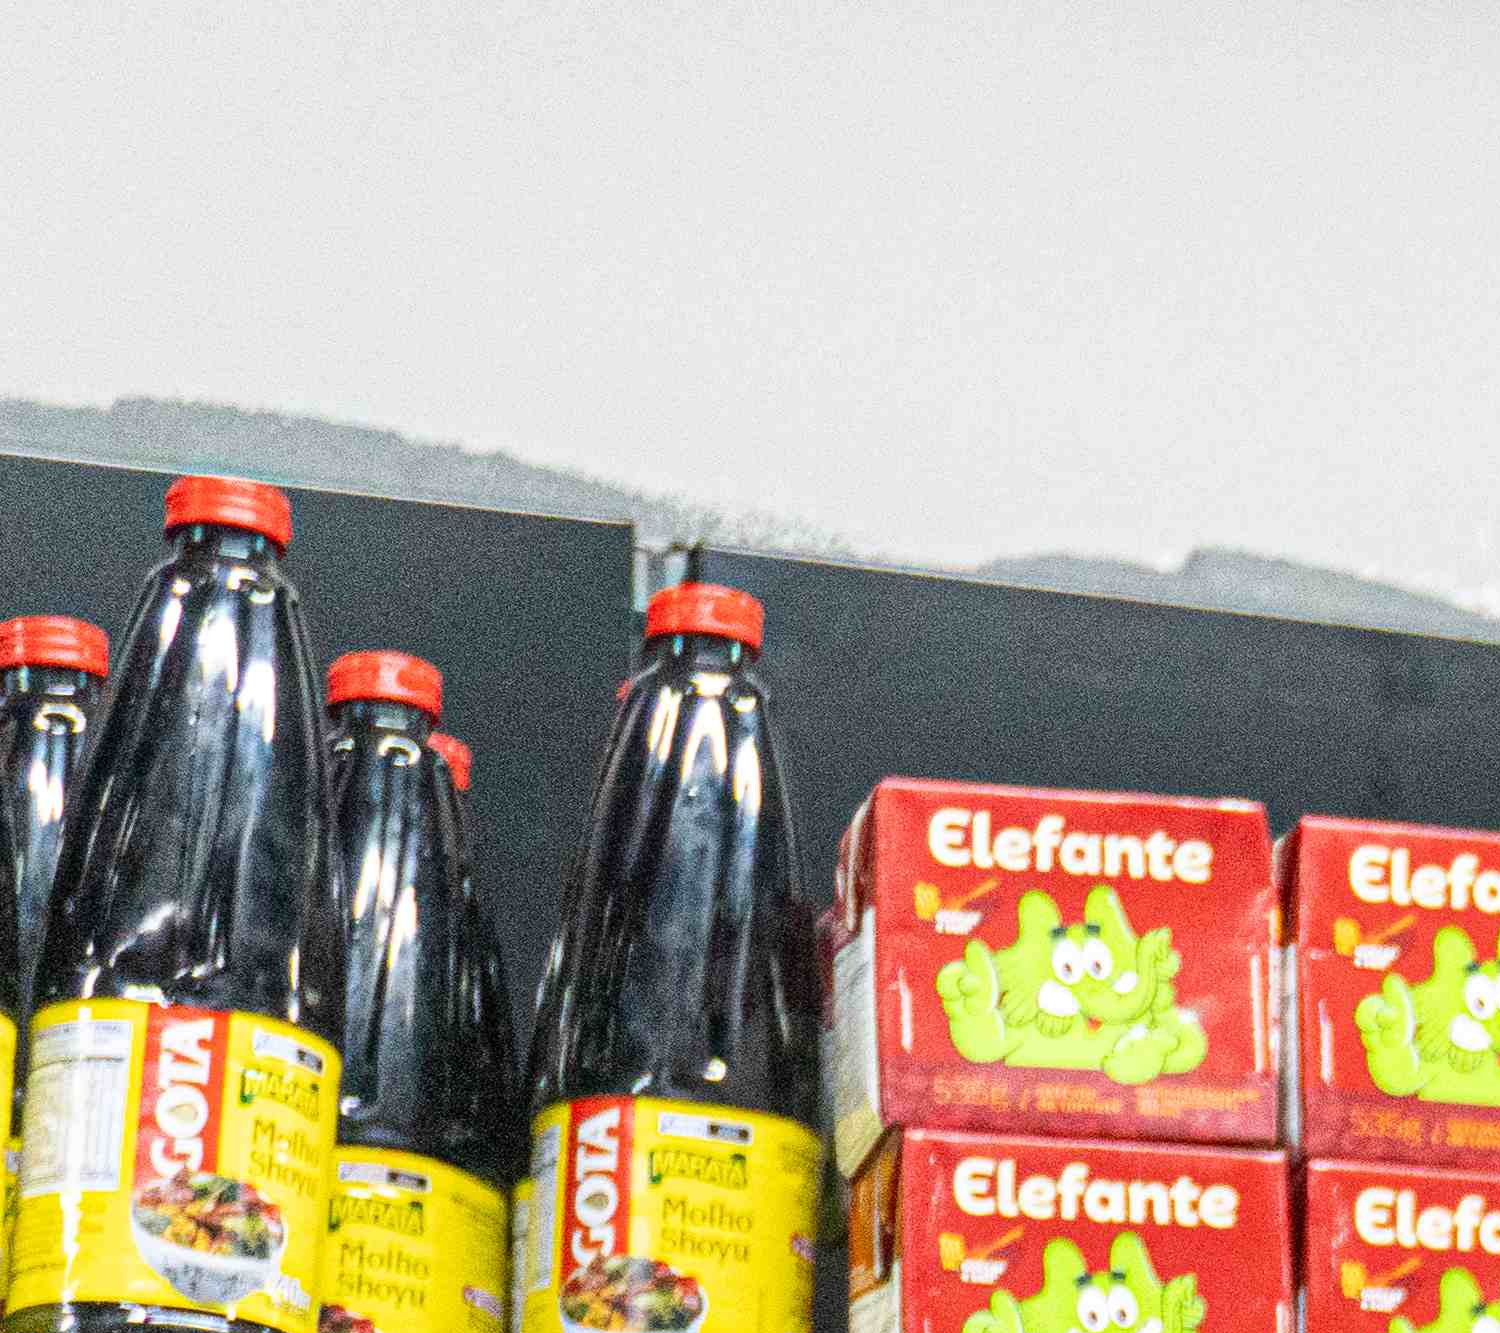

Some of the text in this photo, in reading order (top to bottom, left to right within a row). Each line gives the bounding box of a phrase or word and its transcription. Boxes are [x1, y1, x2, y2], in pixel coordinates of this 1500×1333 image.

[928, 807, 1214, 883] Elefante
[571, 1107, 622, 1268] GOTA
[953, 1156, 1239, 1229] Elefante
[660, 1196, 753, 1230] Molho
[339, 1239, 430, 1283] Molho
[660, 1227, 751, 1263] Shoyu
[336, 1271, 426, 1309] Shoyu
